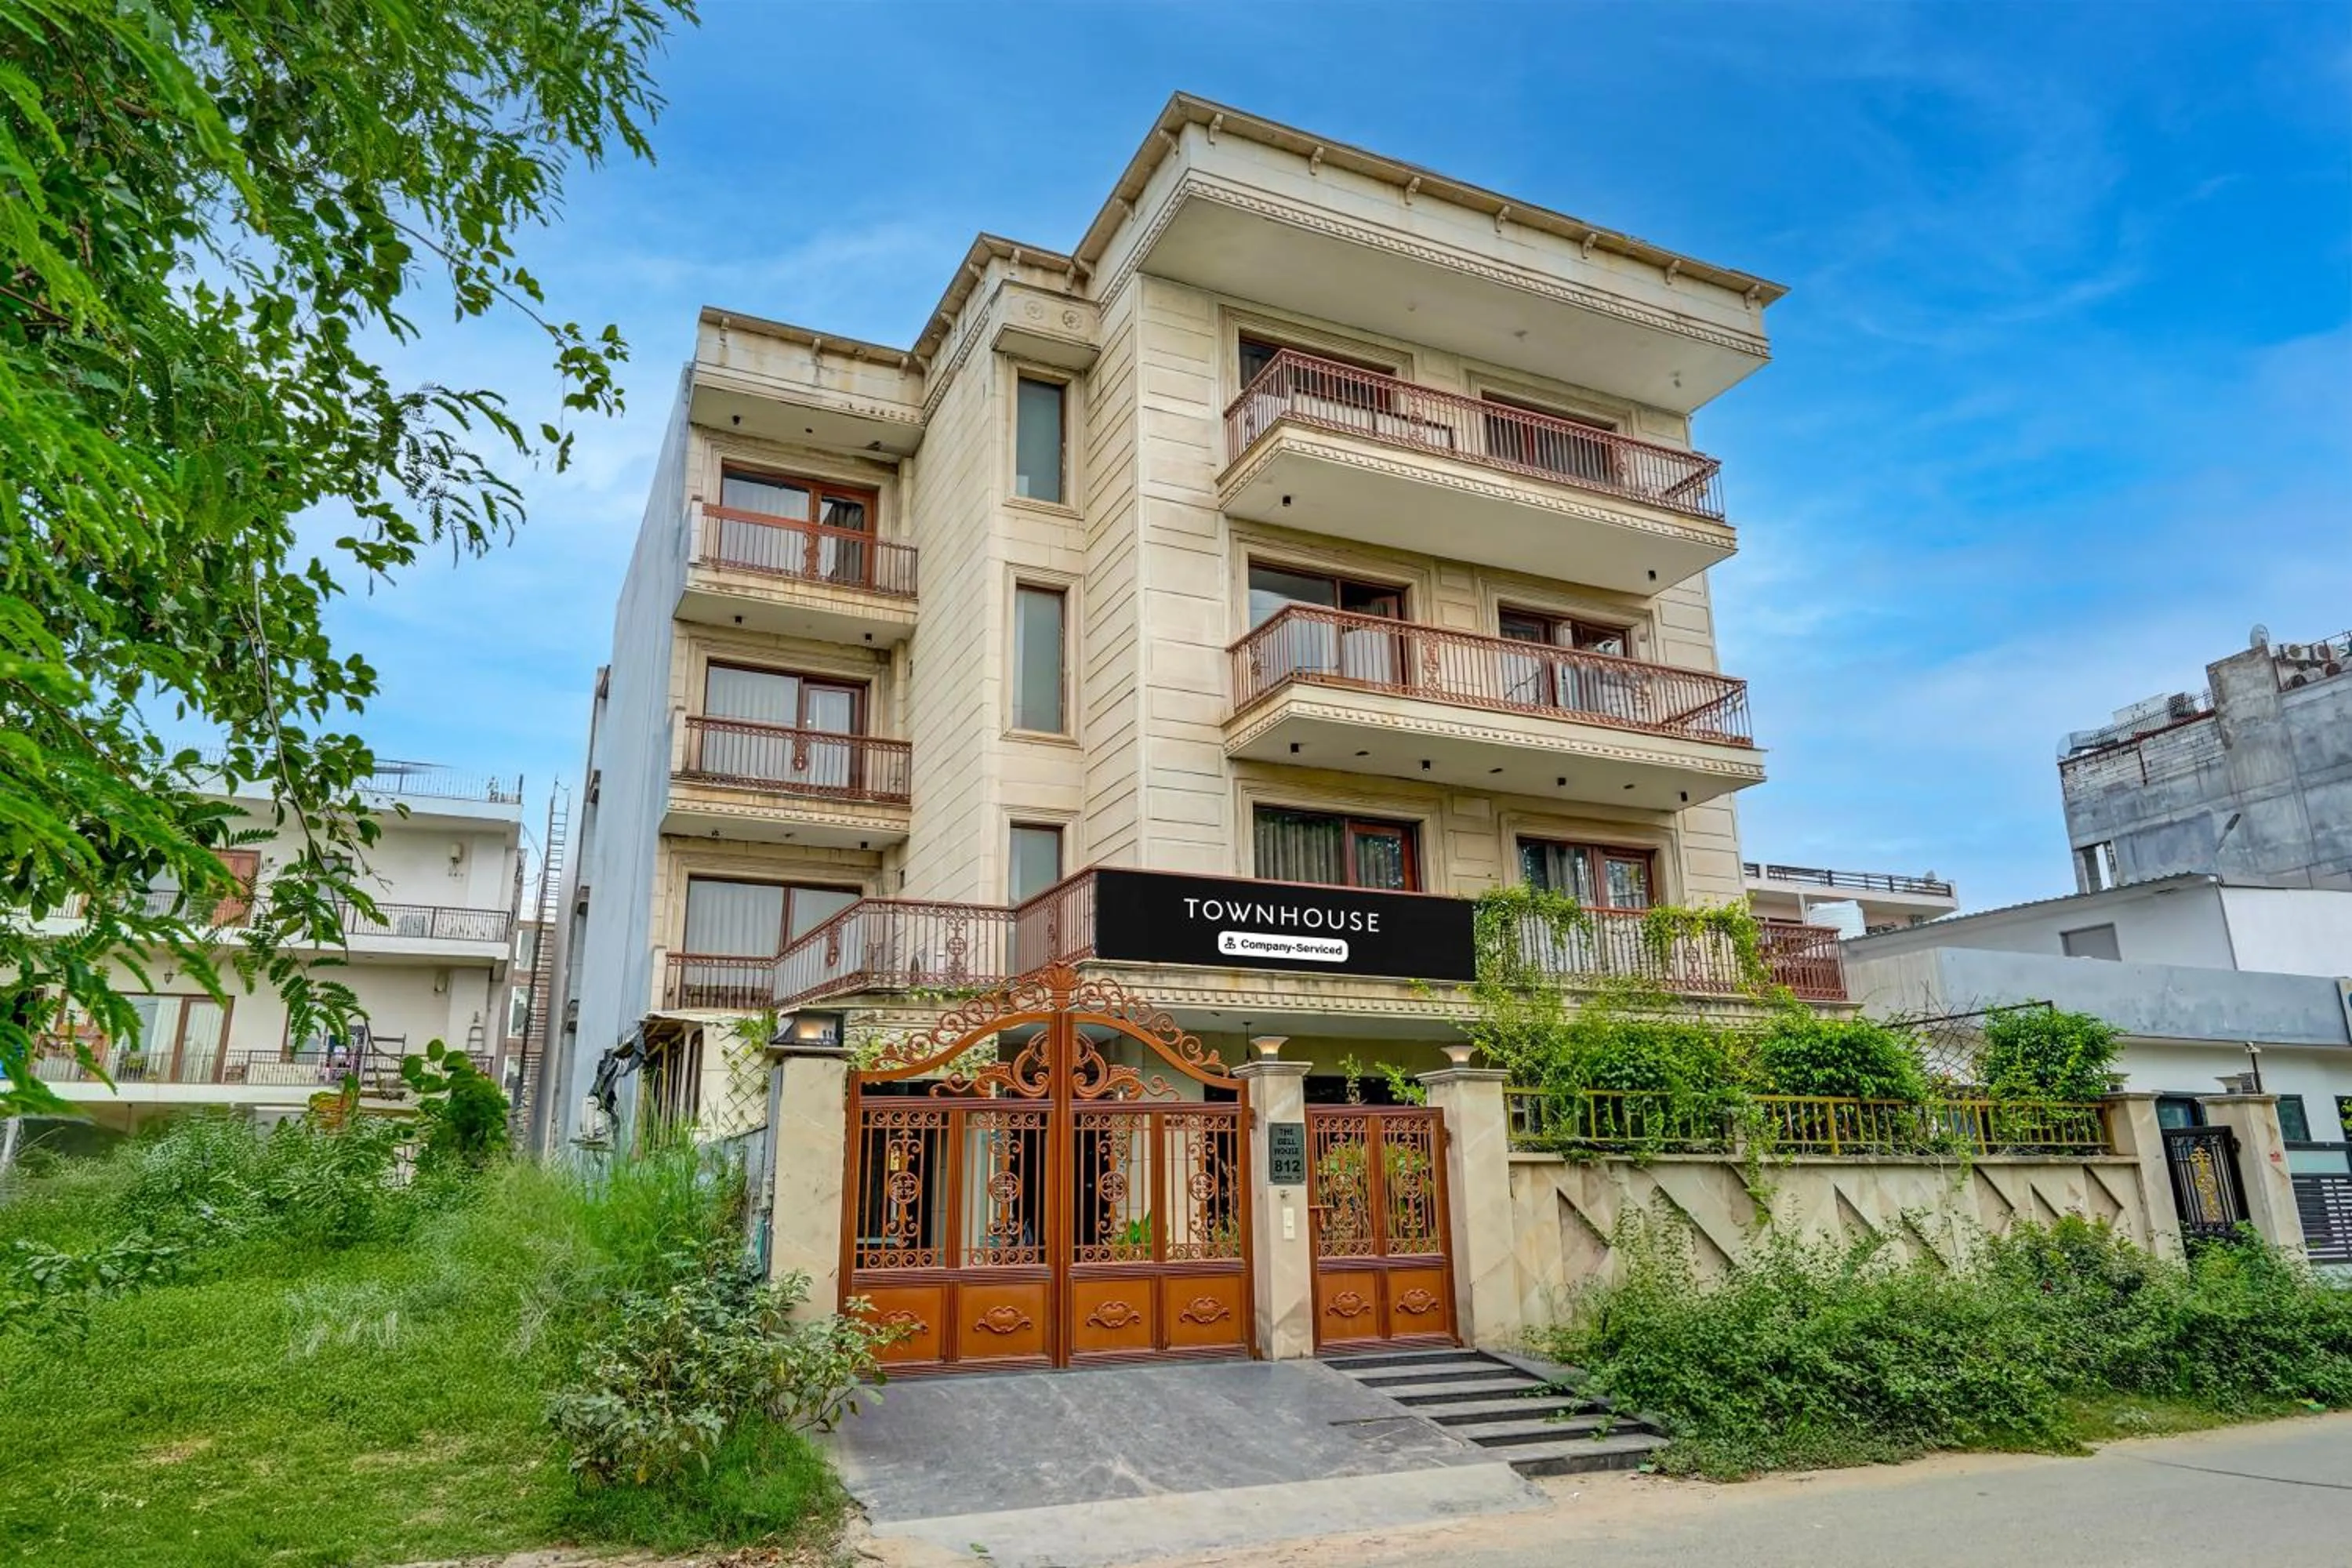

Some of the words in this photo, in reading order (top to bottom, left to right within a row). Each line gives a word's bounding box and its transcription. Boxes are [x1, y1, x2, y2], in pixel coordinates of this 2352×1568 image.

[1183, 898, 1380, 933] TOWNHOUSE
[1240, 938, 1343, 956] Company-Serviced
[1274, 1160, 1301, 1173] 812
